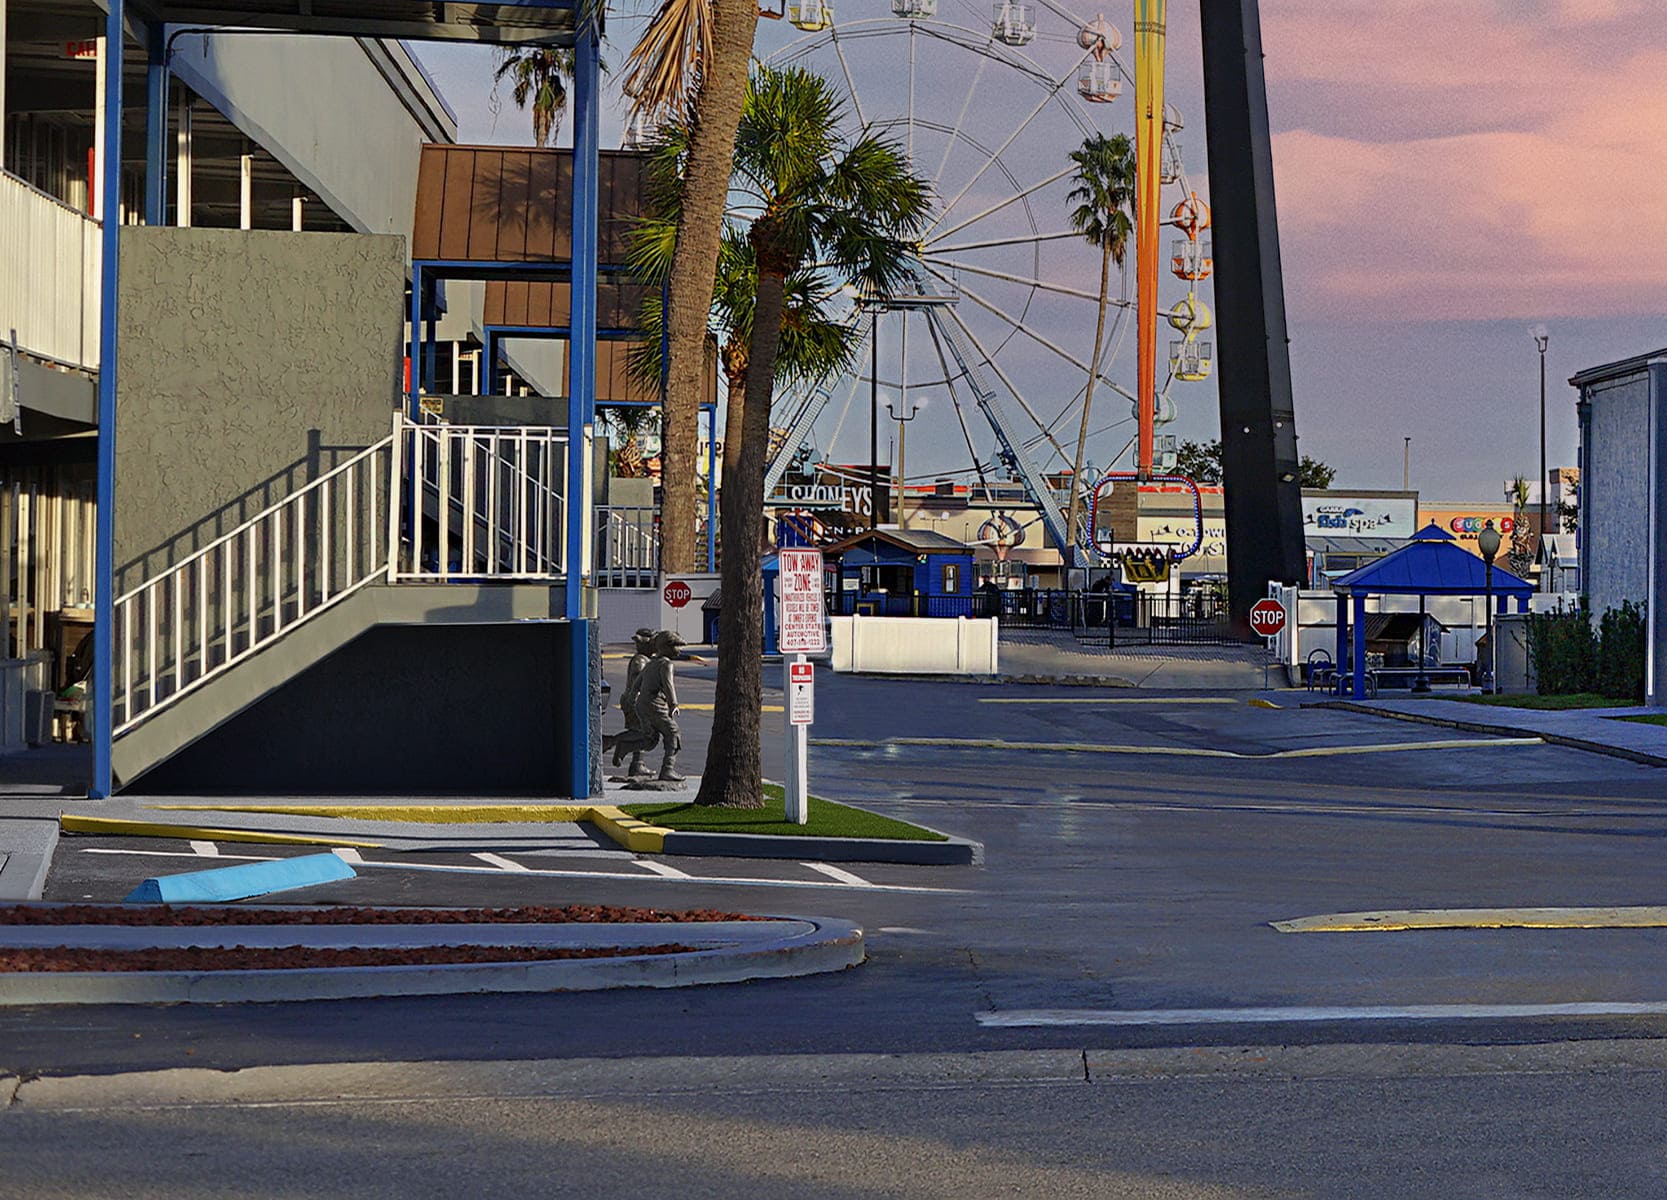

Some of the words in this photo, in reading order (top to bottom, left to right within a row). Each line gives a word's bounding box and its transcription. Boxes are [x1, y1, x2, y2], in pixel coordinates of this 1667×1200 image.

[1349, 518, 1377, 533] spa
[783, 554, 798, 572] TOW
[800, 554, 819, 572] AWAY
[794, 573, 812, 591] ZONE
[665, 589, 690, 601] STOP
[1253, 610, 1284, 625] STOP
